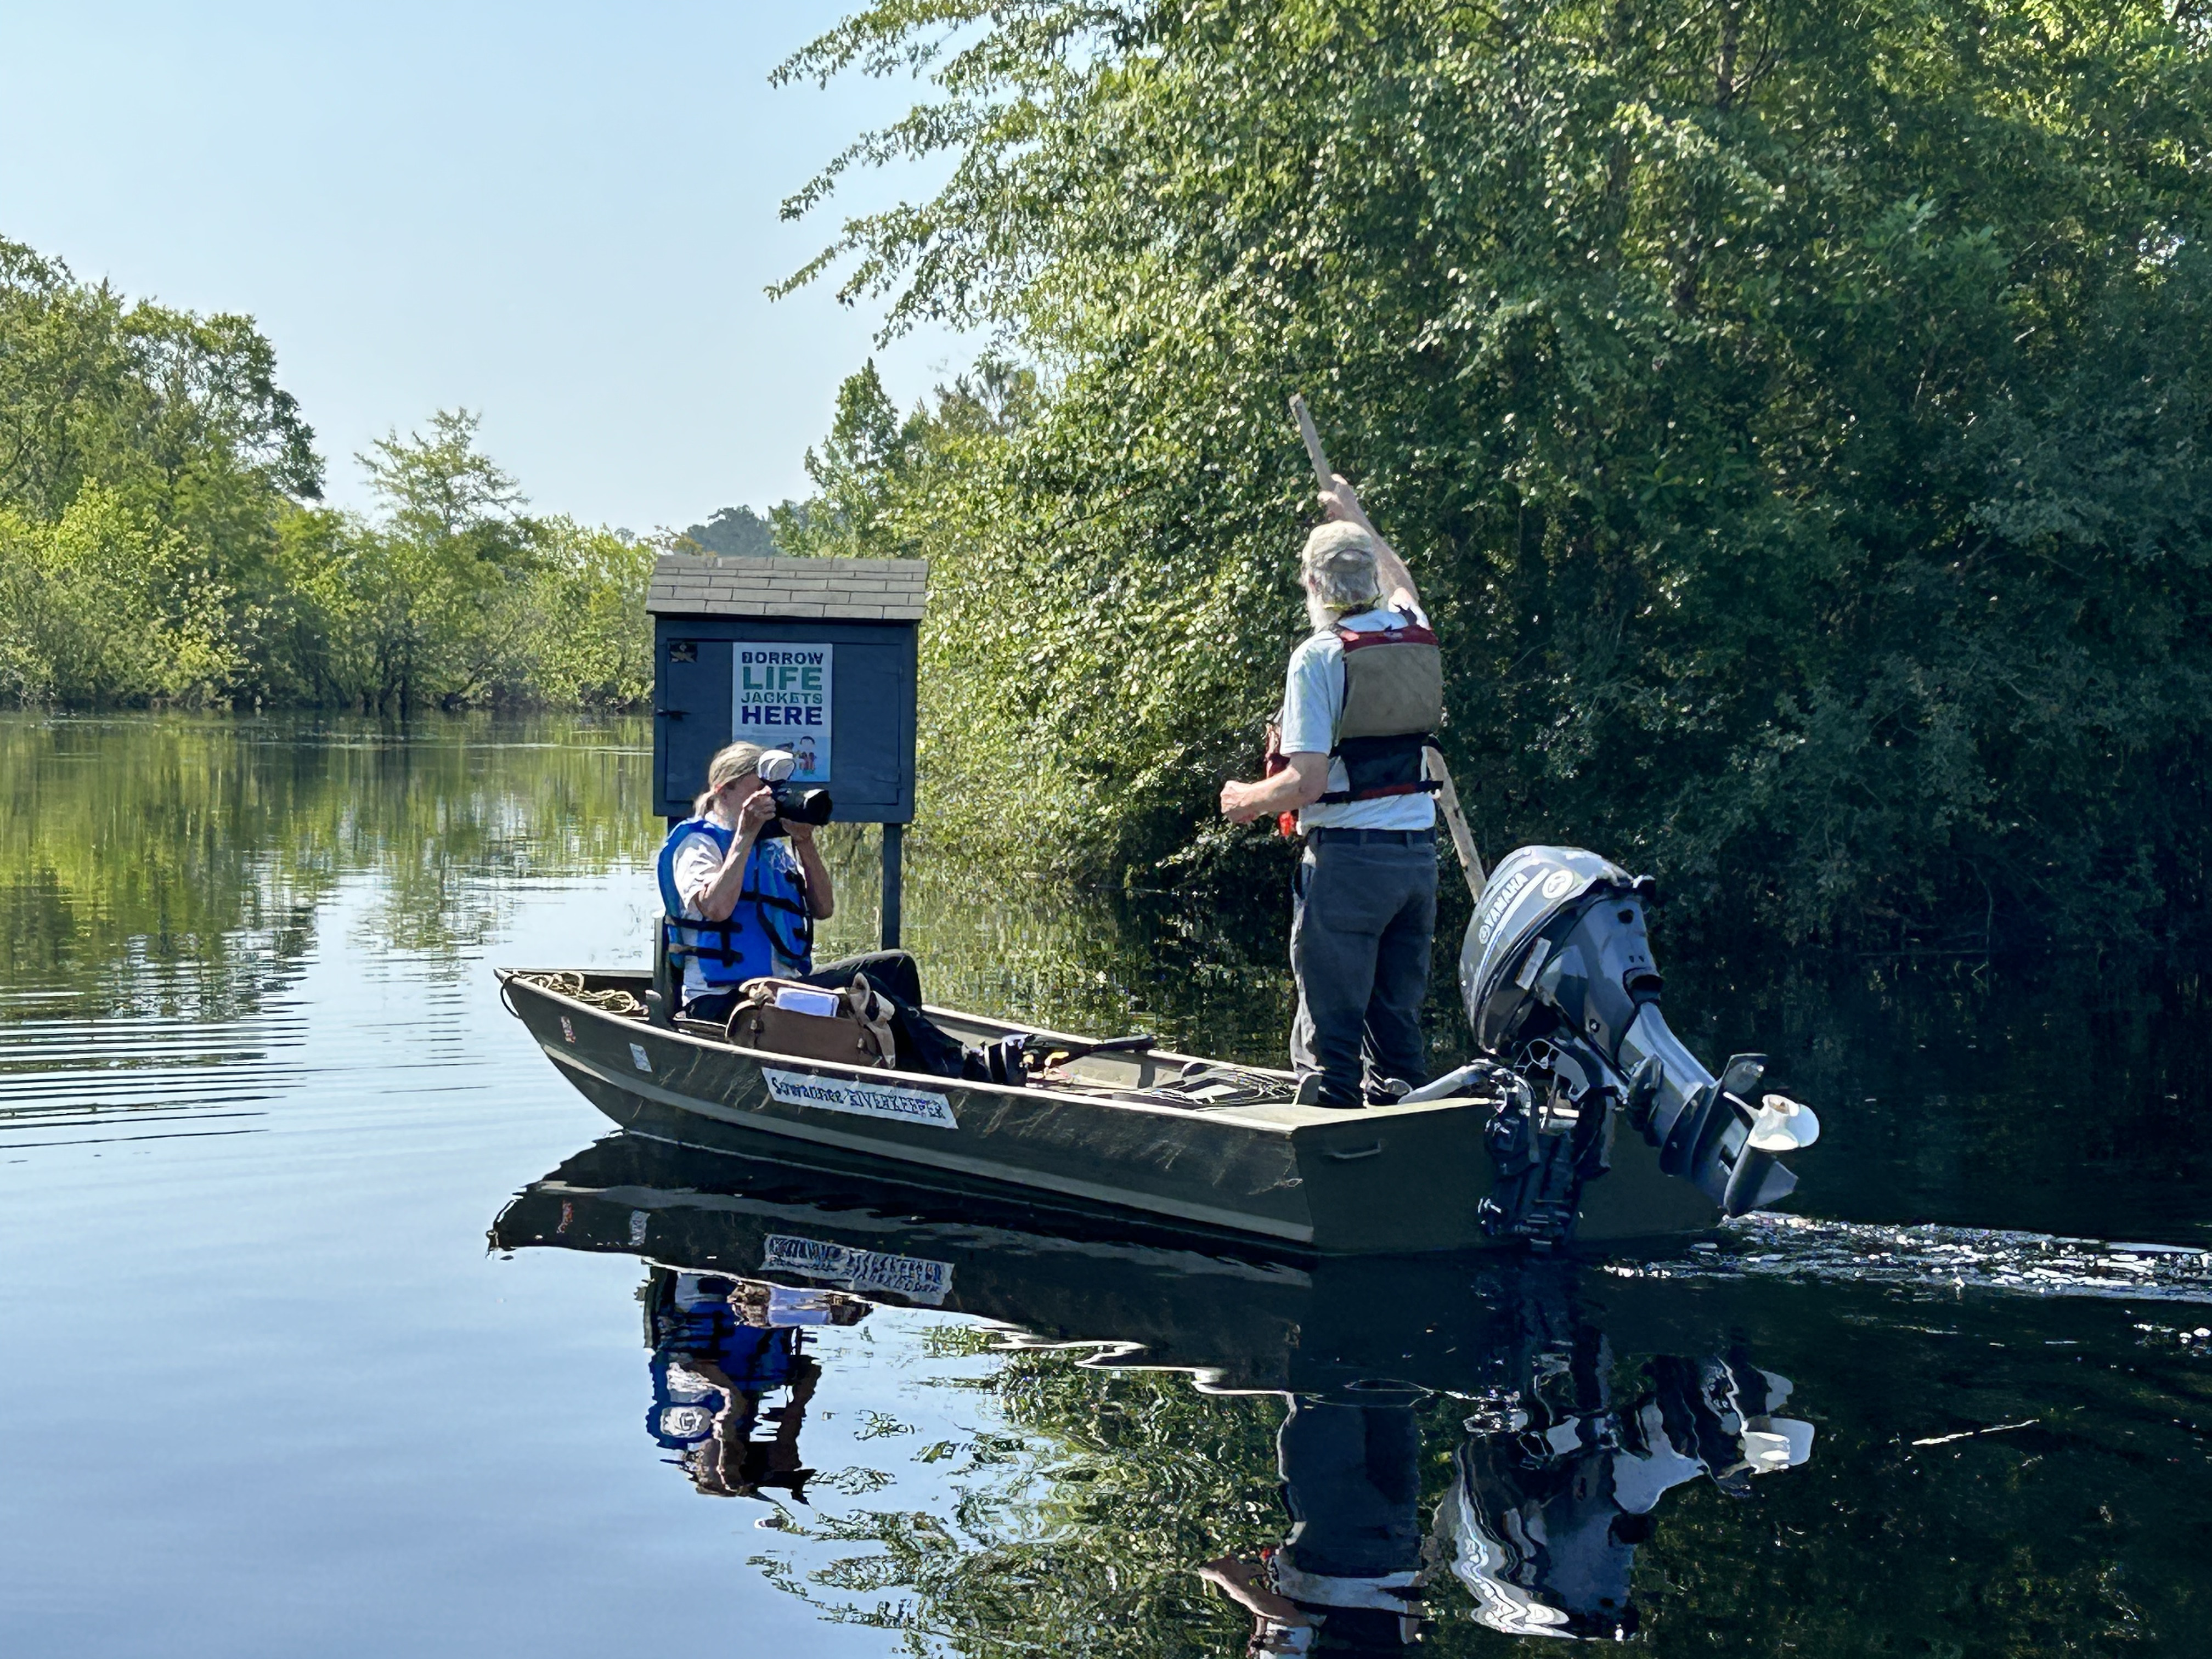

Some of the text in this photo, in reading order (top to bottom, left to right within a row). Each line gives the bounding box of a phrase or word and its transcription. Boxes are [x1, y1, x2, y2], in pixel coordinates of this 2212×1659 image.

[742, 651, 823, 665] BORROW
[743, 667, 822, 690] LIFE
[741, 692, 822, 704] JACKETS
[742, 706, 822, 725] HERE
[1485, 872, 1528, 927] YAMAHA
